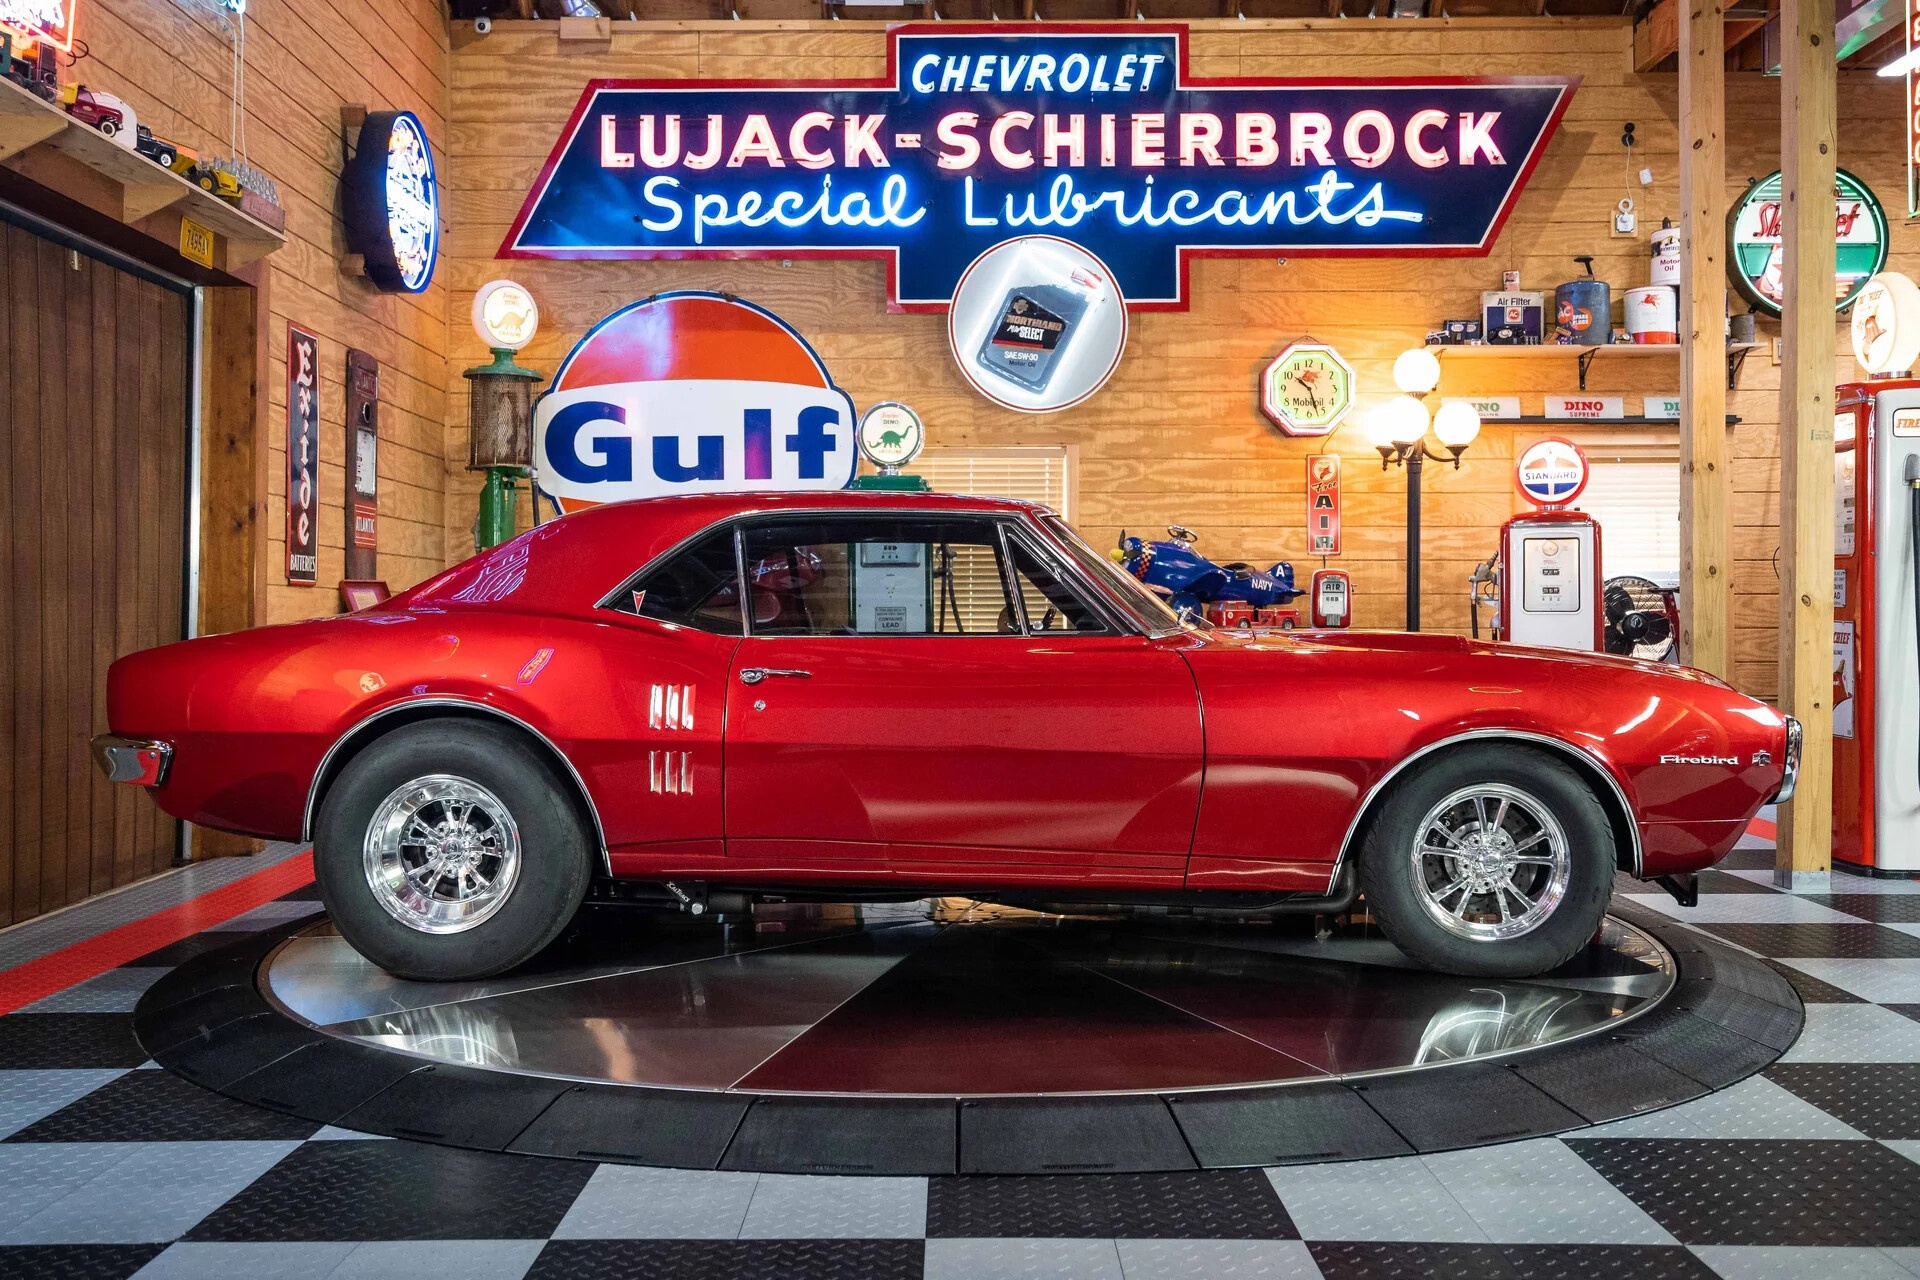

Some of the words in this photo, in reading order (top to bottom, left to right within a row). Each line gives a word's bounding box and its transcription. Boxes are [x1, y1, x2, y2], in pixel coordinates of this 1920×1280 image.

[912, 53, 1165, 92] CHEVROLET
[600, 109, 1507, 169] LUJACK-SCHIERBROCK
[642, 173, 927, 244] Special
[964, 170, 1423, 227] Lubricants
[1497, 297, 1509, 306] Air
[1510, 297, 1532, 306] Filter
[1006, 314, 1063, 332] NORTHLAND
[1019, 326, 1045, 341] SELECT
[1004, 351, 1018, 360] SAE
[1293, 363, 1300, 371] 11
[1304, 359, 1313, 368] 12
[1320, 362, 1324, 370] 1
[1284, 371, 1293, 380] 10
[1329, 371, 1334, 380] 2
[1280, 385, 1286, 393] 9
[1332, 385, 1338, 393] 3
[1284, 398, 1290, 407] 8
[1329, 398, 1334, 406] 4
[1563, 401, 1604, 411] DINO
[1306, 410, 1312, 418] 6
[1320, 407, 1326, 415] 5
[545, 400, 839, 484] Gulf
[1525, 471, 1577, 481] STANDARD
[356, 516, 375, 534] ATLANTIC
[290, 554, 316, 573] BATTERIES
[1276, 564, 1285, 577] A
[1251, 578, 1273, 592] NAVY
[1325, 582, 1341, 591] AIR
[1660, 754, 1740, 765] Firebird
